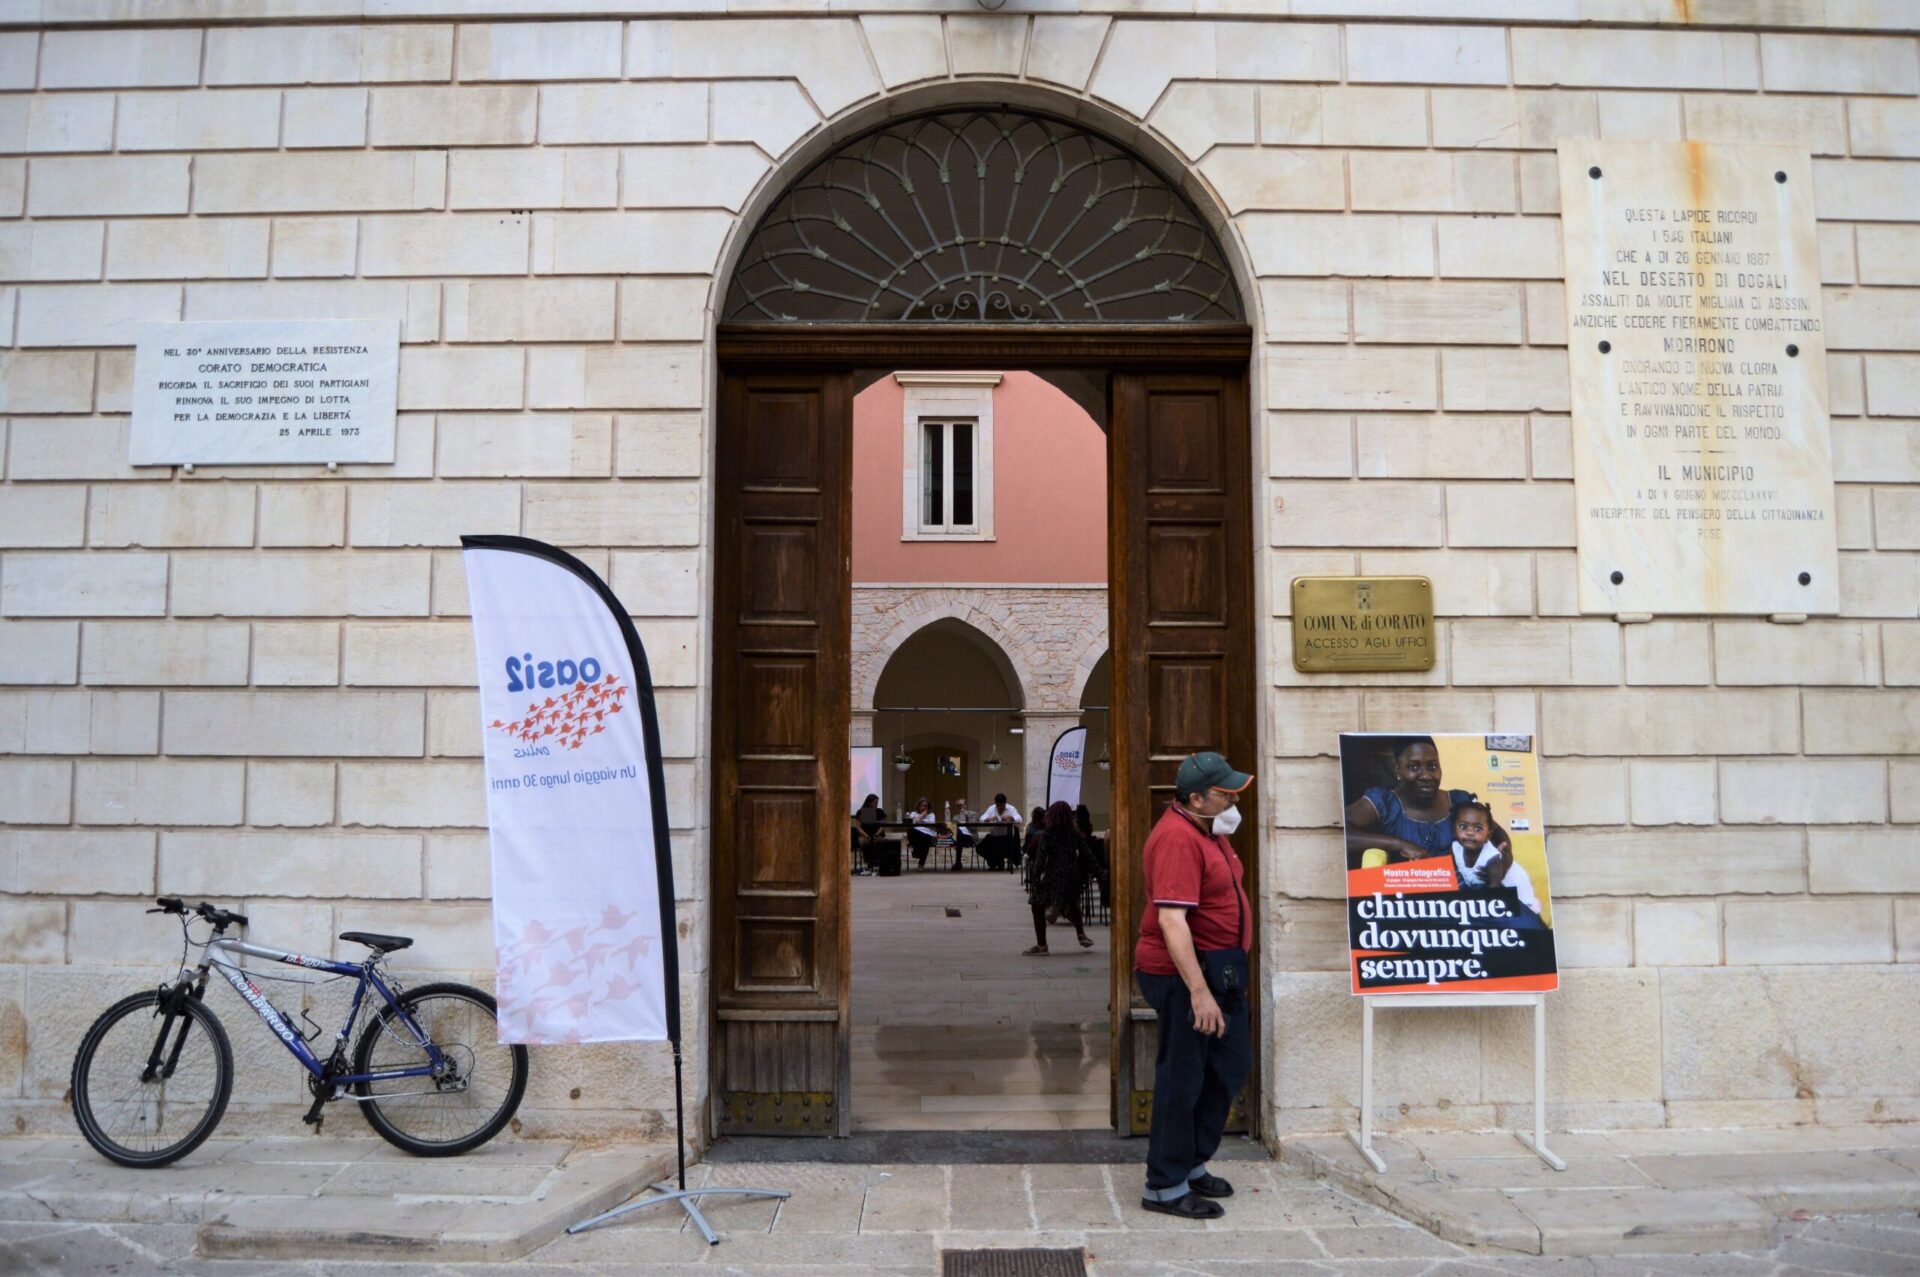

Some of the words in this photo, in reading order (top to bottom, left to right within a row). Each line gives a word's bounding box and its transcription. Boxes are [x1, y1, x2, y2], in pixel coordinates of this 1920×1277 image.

[1673, 209, 1711, 222] LAPIDE
[1717, 210, 1758, 224] RICORDI
[1691, 230, 1733, 244] ITALIANI
[1616, 250, 1637, 263] CHE
[1645, 251, 1652, 263] A
[1675, 251, 1689, 264] 26
[1696, 251, 1740, 265] GENNAIO
[1602, 270, 1630, 286] NEL
[1640, 271, 1705, 287] DESERTO
[1715, 273, 1728, 288] DI
[1738, 273, 1787, 289] DOGALI
[1582, 294, 1629, 308] ASSALITI
[1636, 294, 1650, 308] DA
[1658, 295, 1693, 308] MOLTE
[1700, 295, 1744, 309] MIGLIAIA
[1751, 296, 1761, 310] DI
[1624, 315, 1666, 329] CEDERE
[1673, 316, 1739, 330] FIERAMENTE
[1745, 318, 1820, 331] COMBATTENDO
[164, 348, 180, 356] NEL
[207, 347, 271, 356] ANNIVERSARIO
[277, 347, 306, 355] DELLA
[313, 346, 368, 354] RESISTENZA
[1664, 337, 1734, 353] MORIRONO
[198, 363, 241, 373] CORATO
[251, 362, 327, 372] DEMOCRATICA
[1623, 360, 1679, 374] ONORANDO
[1701, 361, 1734, 375] NUOVA
[158, 381, 197, 390] RICORDA
[204, 381, 213, 389] IL
[218, 380, 267, 389] SACRIFICIO
[273, 380, 288, 388] DEI
[294, 380, 313, 388] SUOI
[320, 379, 369, 388] PARTIGIANI
[1672, 382, 1701, 396] NOME
[1708, 383, 1743, 397] DELLA
[1748, 383, 1783, 397] PATRIA
[176, 397, 213, 405] RINNOVA
[221, 397, 229, 405] IL
[235, 396, 252, 405] SUO
[258, 396, 300, 404] IMPEGNO
[305, 396, 314, 404] DI
[320, 395, 350, 404] LOTTA
[174, 413, 190, 422] PER
[197, 413, 209, 421] LA
[216, 412, 276, 421] DEMOCRAZIA
[283, 412, 288, 420] E
[295, 412, 307, 420] LA
[1621, 402, 1627, 416] E
[1634, 403, 1711, 417] RAVVIVANDONE
[1717, 404, 1726, 417] IL
[1732, 404, 1784, 418] RISPETTO
[279, 428, 289, 436] 25
[298, 428, 331, 436] APRILE
[341, 428, 359, 436] 1973
[1627, 424, 1636, 438] IN
[1644, 425, 1668, 438] OGNI
[1675, 425, 1709, 439] PARTE
[1716, 425, 1737, 439] DEL
[1745, 426, 1781, 440] MONDO
[1658, 465, 1671, 480] IL
[1682, 465, 1754, 481] MUNICIPIO
[1637, 489, 1642, 499] A
[1674, 489, 1706, 500] GIUGNO
[1653, 508, 1671, 520] DEL
[1676, 508, 1721, 520] PENSIERO
[1726, 509, 1756, 520] DELLA
[1761, 509, 1824, 521] CITTADINANZA
[1304, 615, 1357, 630] COMUNE
[1361, 615, 1371, 630] di
[1376, 614, 1425, 630] CORATO
[1305, 638, 1358, 649] ACCESSO
[1365, 638, 1390, 648] AGLI
[1396, 637, 1427, 648] UFFICI
[1060, 751, 1080, 759] oasi2
[1383, 869, 1409, 877] Mostra
[1410, 868, 1451, 878] Fotografica
[1356, 892, 1512, 925] chiunque.
[1358, 922, 1525, 954] dovunque.
[1361, 957, 1488, 985] sempre.
[230, 974, 295, 1040] LOMBARDO
